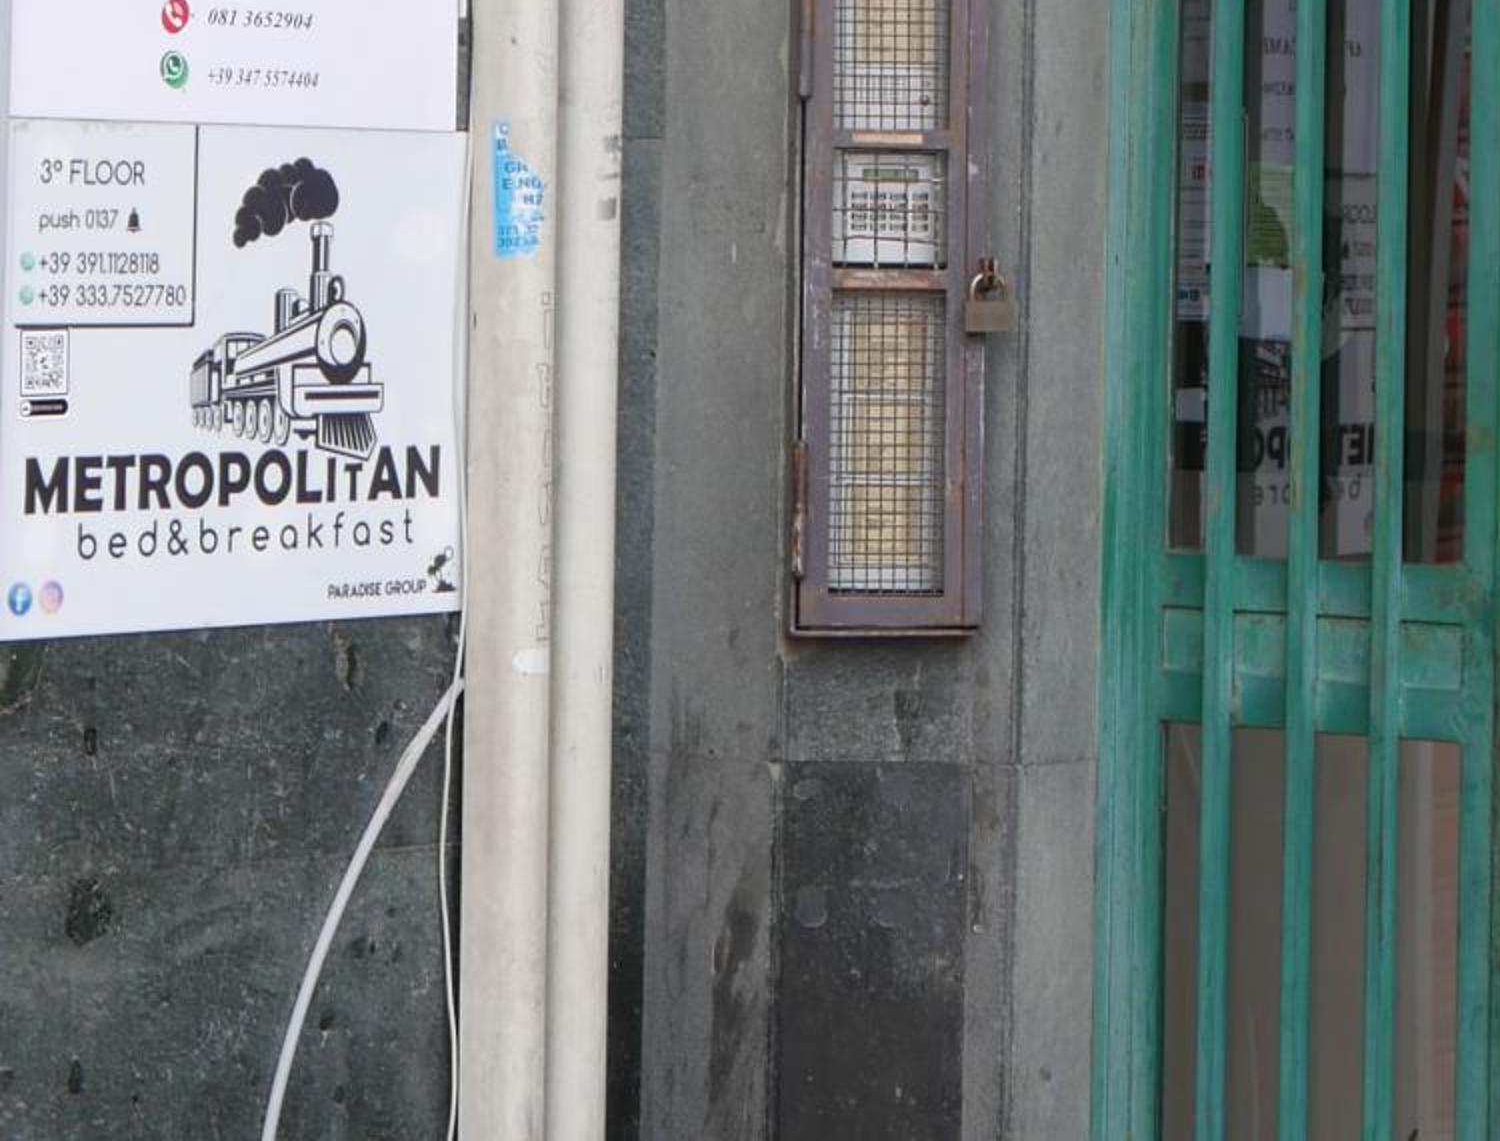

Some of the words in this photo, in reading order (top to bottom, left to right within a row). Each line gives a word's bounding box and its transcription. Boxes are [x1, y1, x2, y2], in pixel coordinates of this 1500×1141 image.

[207, 7, 238, 26] 081
[243, 10, 314, 30] 3652904
[208, 66, 233, 86] +39
[235, 67, 262, 86] 347
[69, 159, 146, 185] FLOOR
[38, 210, 81, 233] push
[86, 209, 119, 230] 0137
[38, 252, 71, 275] +39
[38, 285, 71, 307] +39
[76, 285, 187, 307] 333.7527780
[23, 444, 441, 514] METROPOLITAN
[77, 508, 415, 561] bed&breakfast
[327, 581, 382, 599] PARADISE
[385, 579, 427, 595] GROUP
